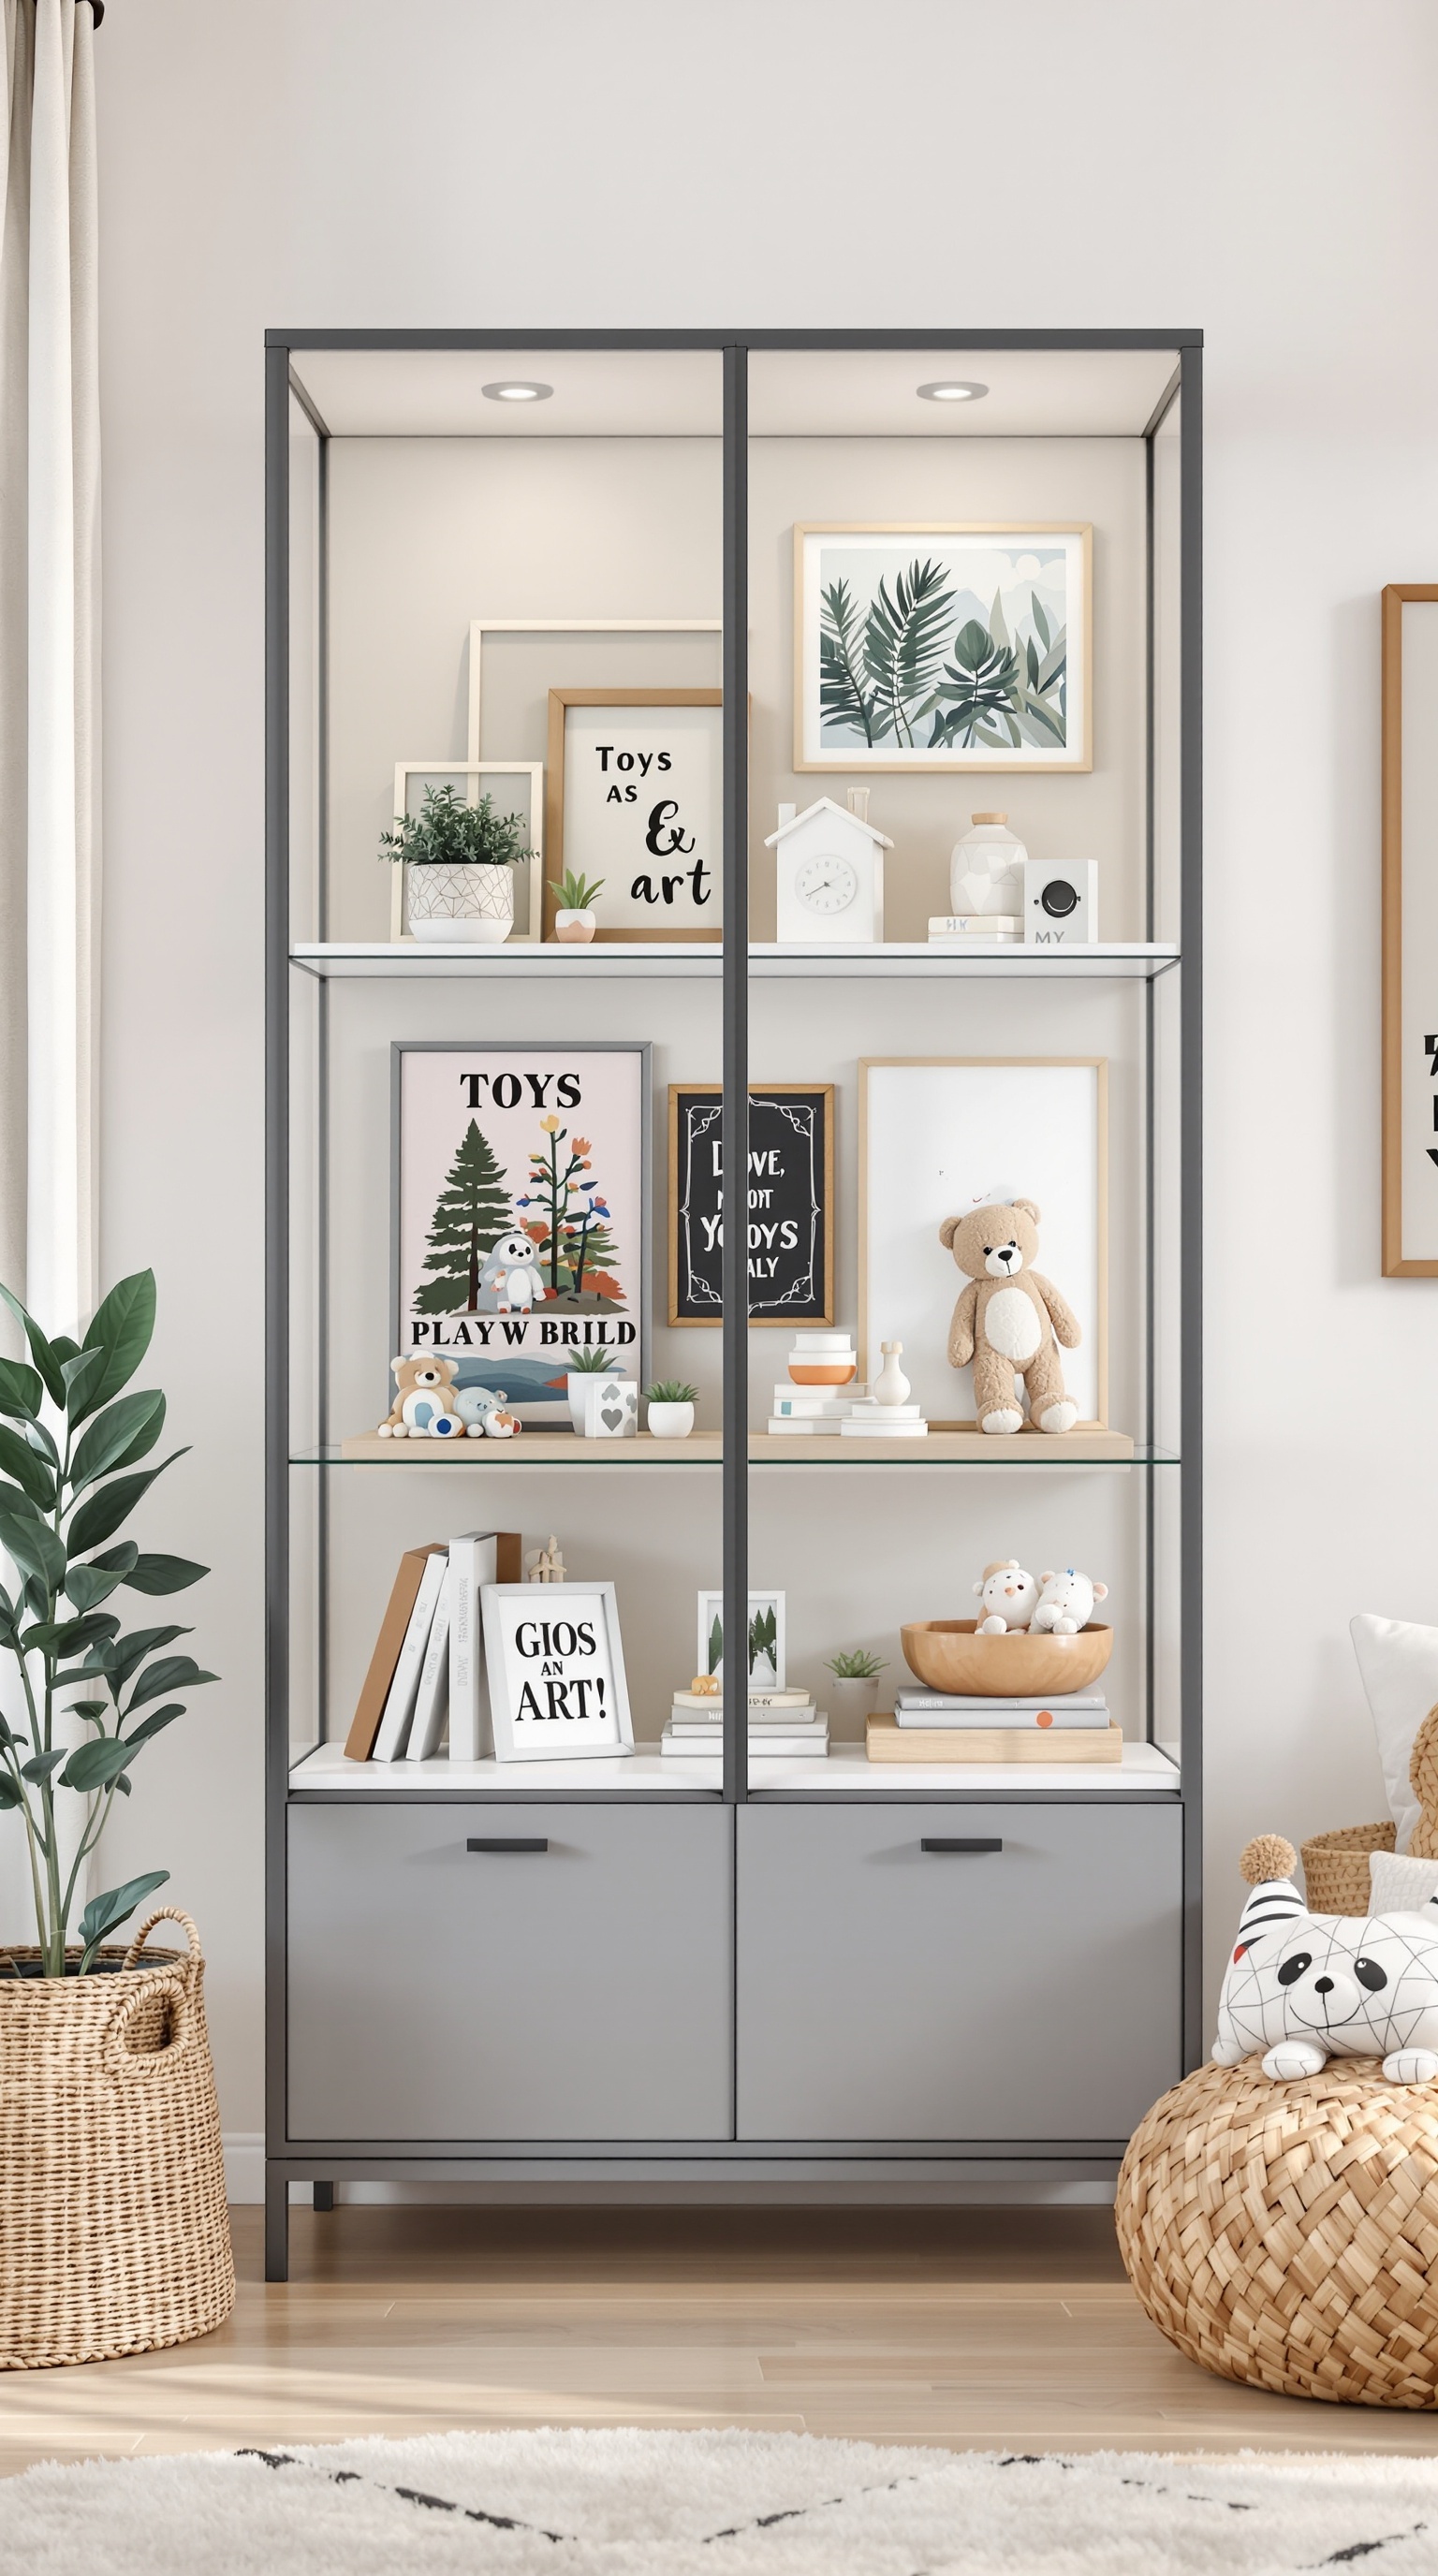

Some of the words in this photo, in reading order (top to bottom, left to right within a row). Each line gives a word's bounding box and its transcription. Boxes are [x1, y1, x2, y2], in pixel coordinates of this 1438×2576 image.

[595, 746, 672, 778] Toys
[630, 858, 712, 906] art
[460, 1073, 581, 1109] TOYS
[411, 1321, 530, 1346] PLAYW
[539, 1321, 637, 1346] BRILD
[515, 1621, 596, 1658] GIOS
[540, 1661, 564, 1676] AN
[515, 1677, 607, 1721] ART!
